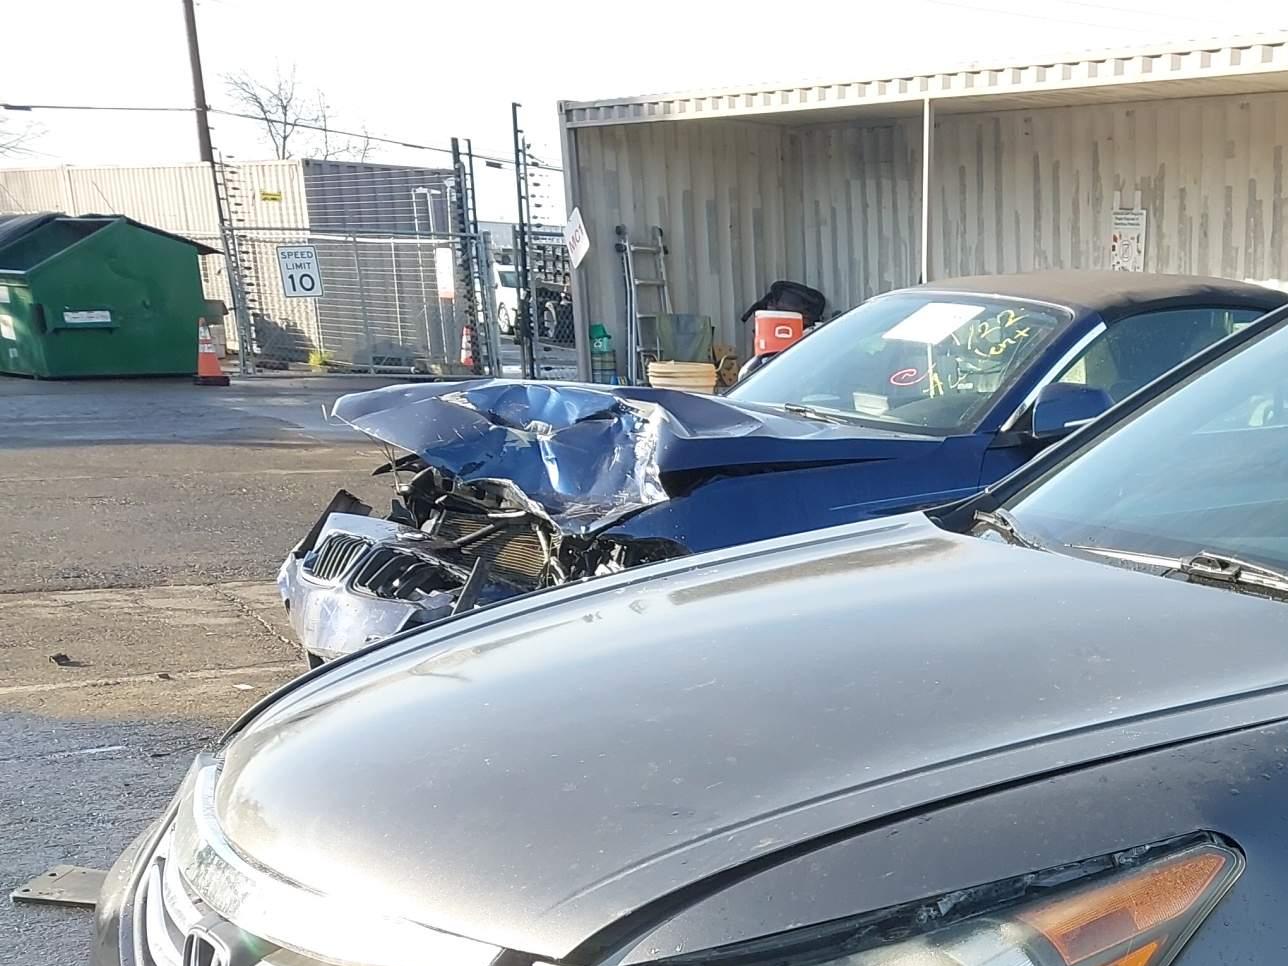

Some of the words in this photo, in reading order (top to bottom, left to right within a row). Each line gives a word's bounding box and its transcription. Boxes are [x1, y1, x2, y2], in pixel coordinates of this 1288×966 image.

[280, 251, 314, 259] SPEED
[285, 262, 311, 270] LIMIT
[288, 273, 315, 292] 10
